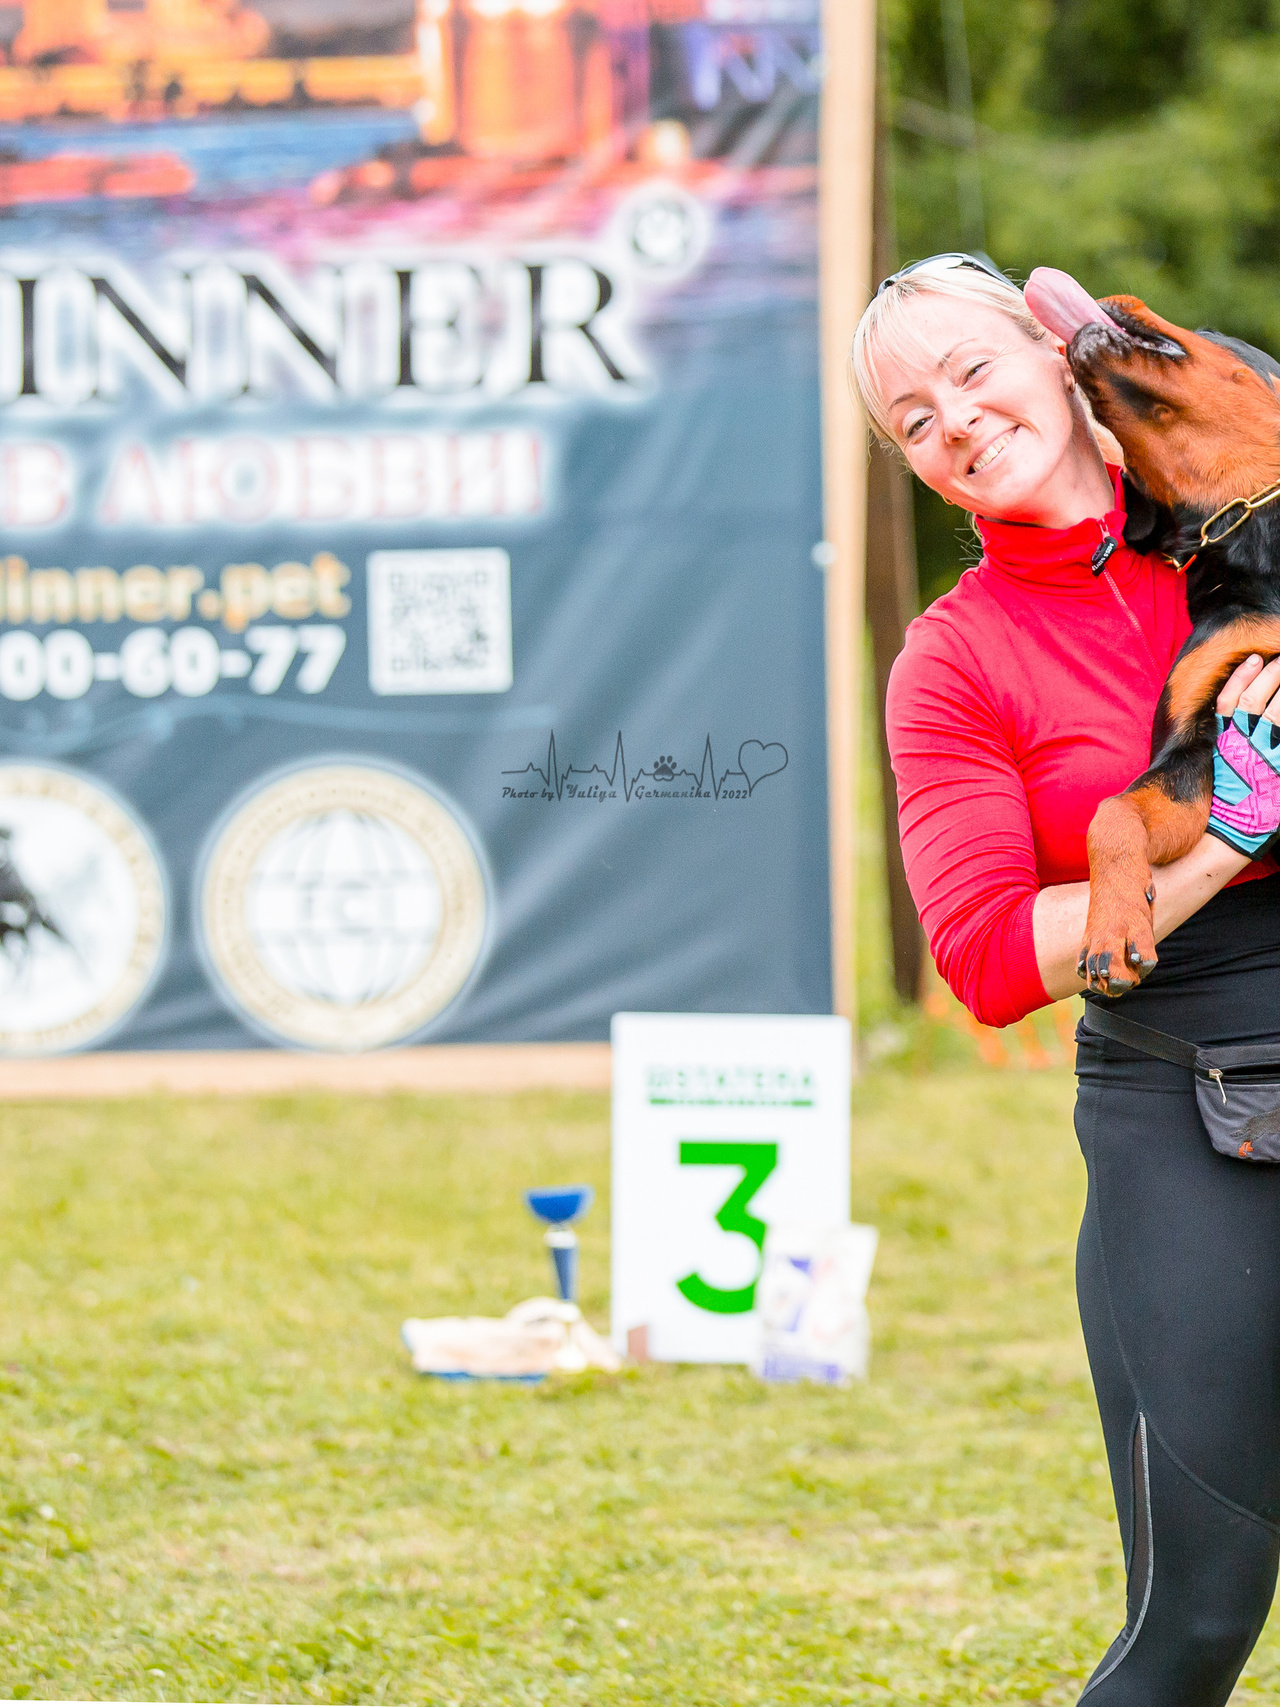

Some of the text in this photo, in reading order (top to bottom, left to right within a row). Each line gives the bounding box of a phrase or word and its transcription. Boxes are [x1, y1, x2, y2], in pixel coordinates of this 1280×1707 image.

[0, 553, 352, 632] inner.pet
[0, 624, 347, 701] 00-60-77
[675, 1141, 780, 1315] 3
